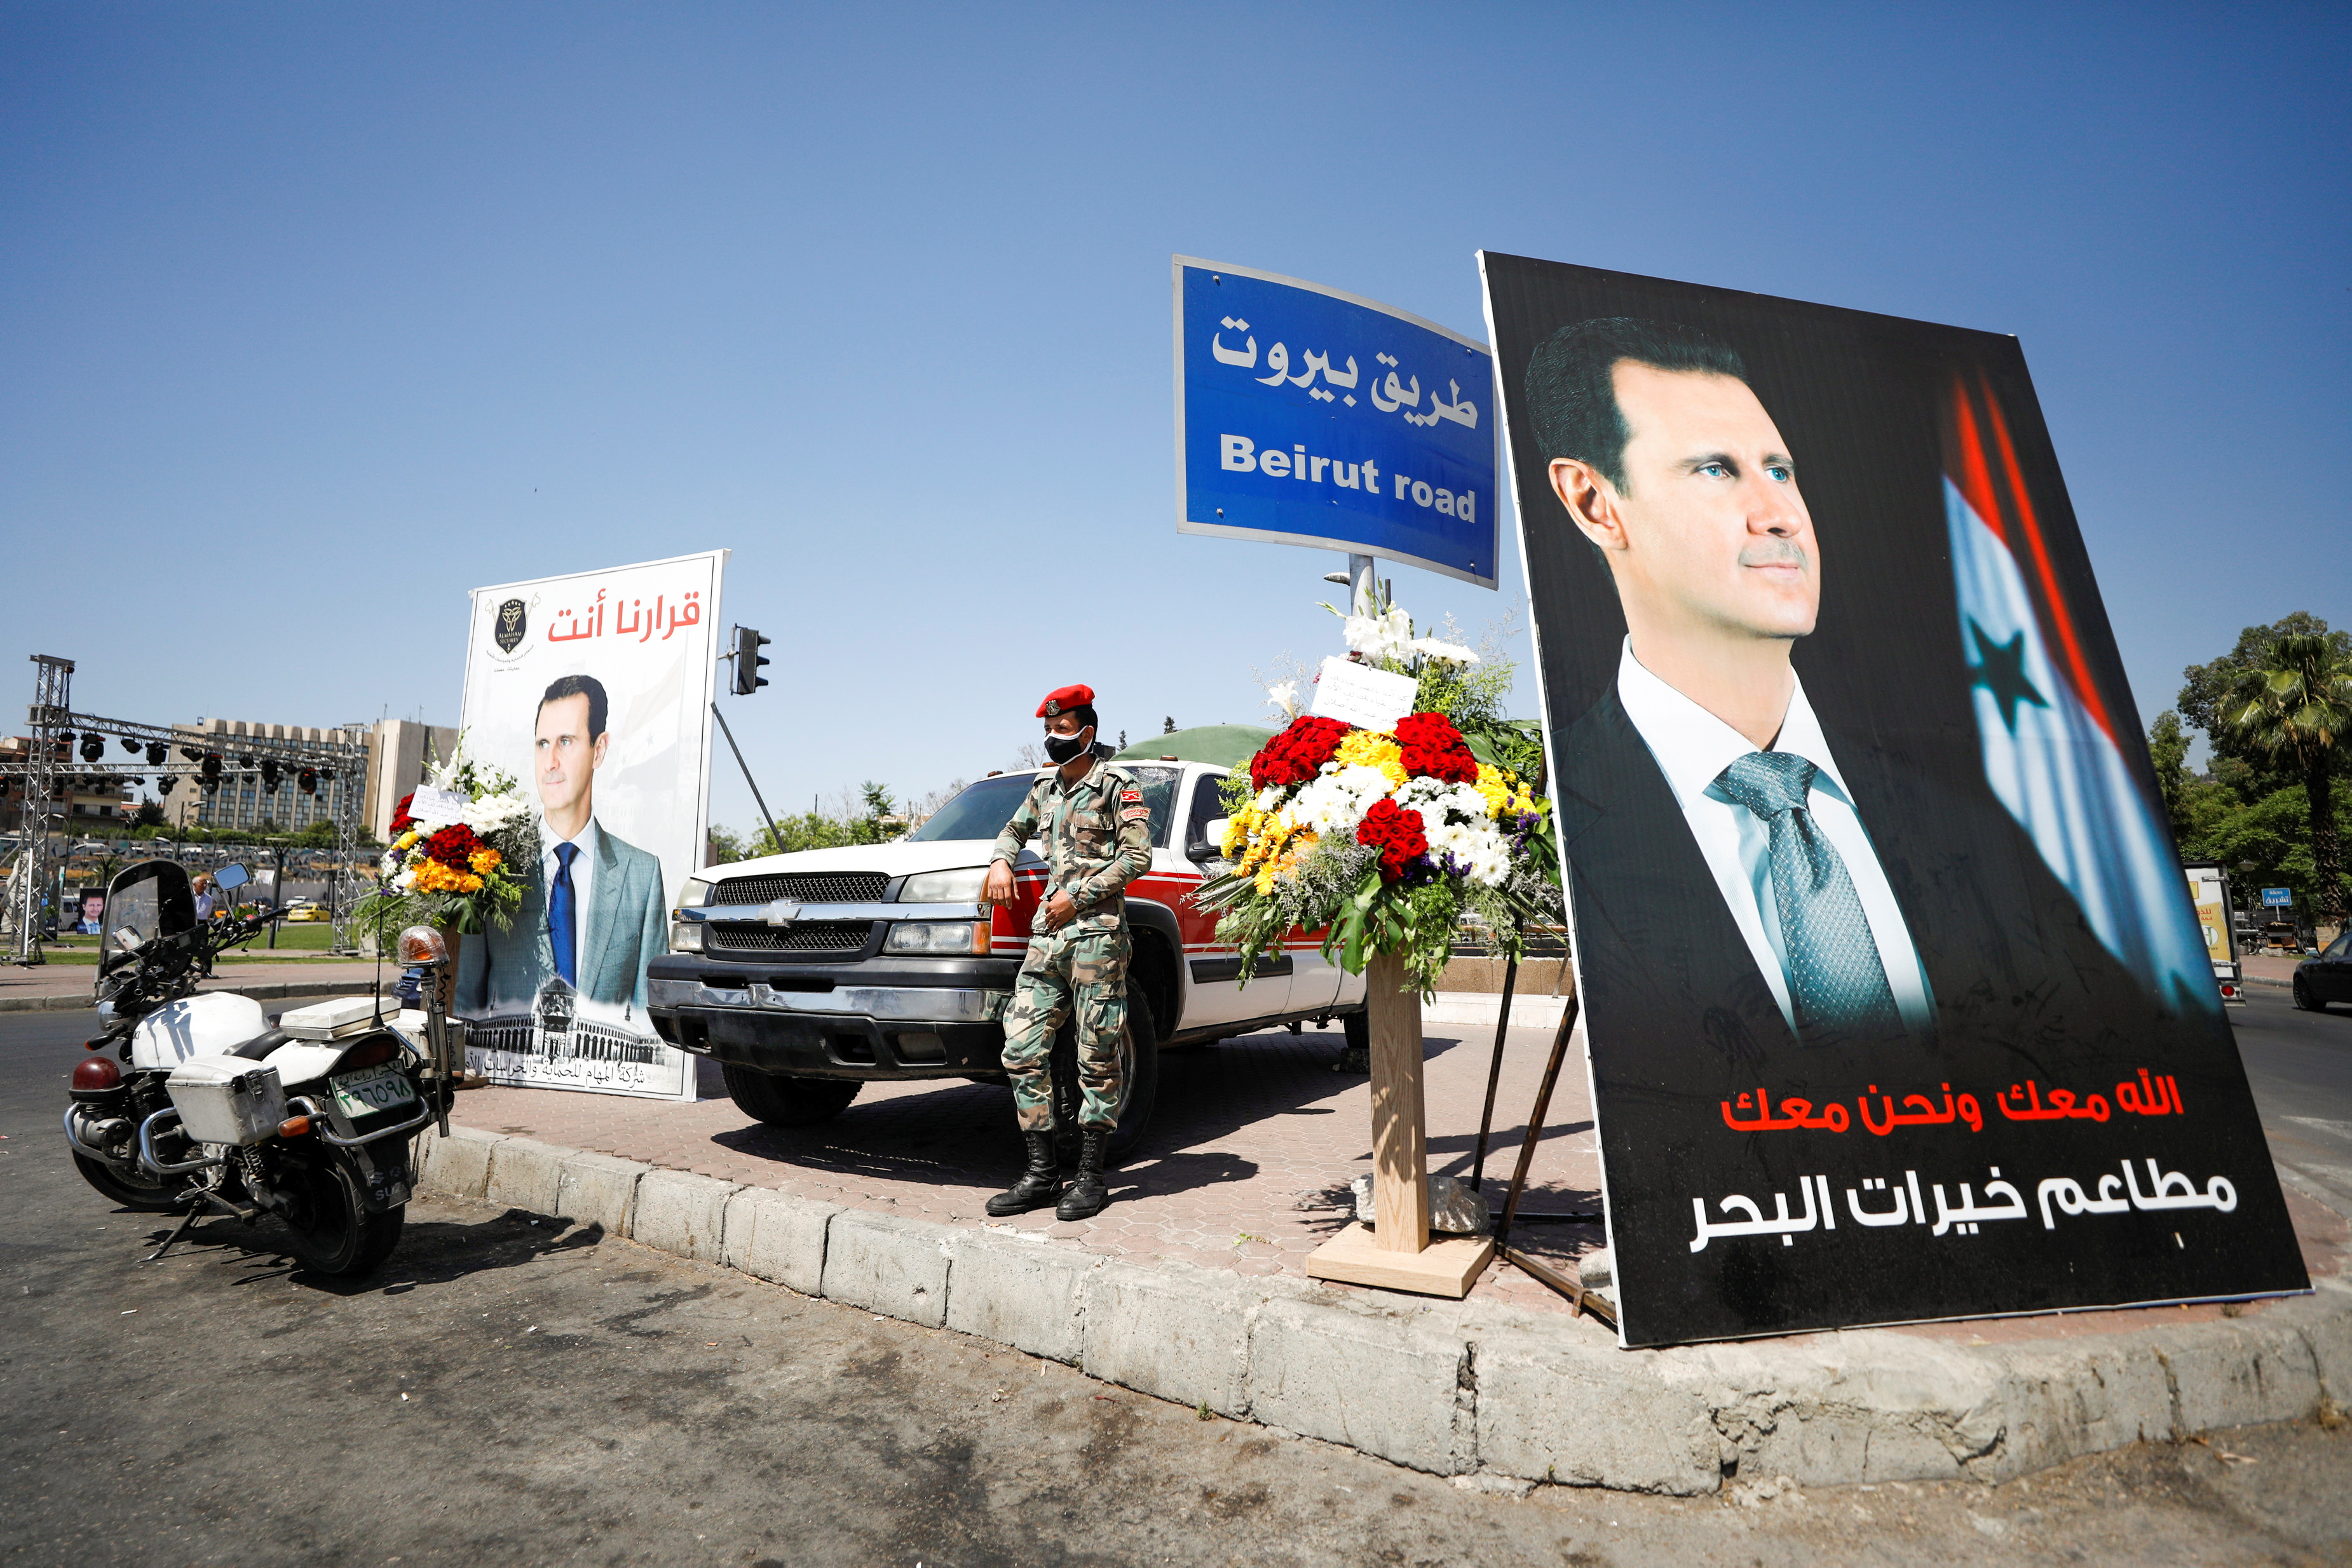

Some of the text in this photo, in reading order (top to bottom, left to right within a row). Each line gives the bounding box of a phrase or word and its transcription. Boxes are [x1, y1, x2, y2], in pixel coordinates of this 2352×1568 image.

[1213, 316, 1478, 429] طريق بيروت
[1220, 433, 1476, 524] Beirut road
[548, 588, 700, 644] قرارنا أنت
[2266, 896, 2289, 904] تشرين
[465, 1050, 480, 1069] الأم
[484, 1057, 536, 1078] والحراسات
[542, 1060, 581, 1081] للحماية
[585, 1065, 614, 1086] المهام
[619, 1067, 645, 1088] شركة
[1720, 1067, 2184, 1136] الله معك ونحن معك
[1690, 1158, 2238, 1253] مطاعم خيرات البحر
